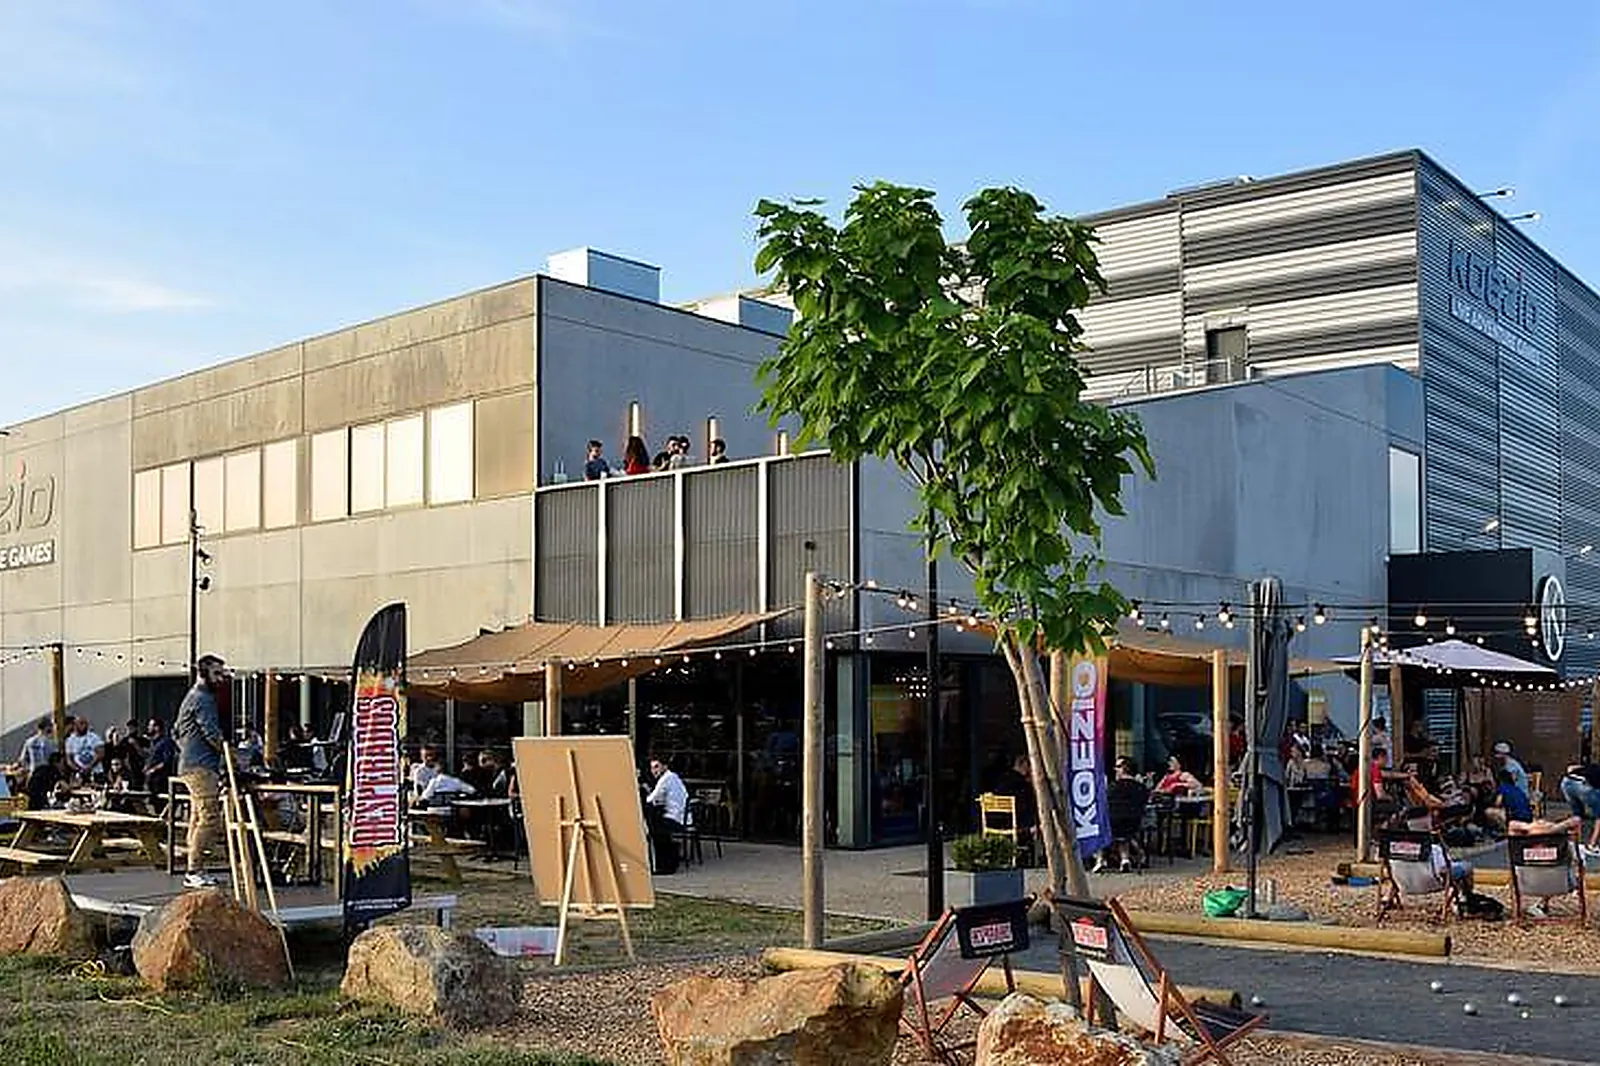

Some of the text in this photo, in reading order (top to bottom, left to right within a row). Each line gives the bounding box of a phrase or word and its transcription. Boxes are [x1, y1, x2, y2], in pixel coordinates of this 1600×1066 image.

[9, 542, 52, 566] GAMES
[351, 695, 399, 844] DESPERADOS
[1070, 660, 1100, 840] KOEZIO
